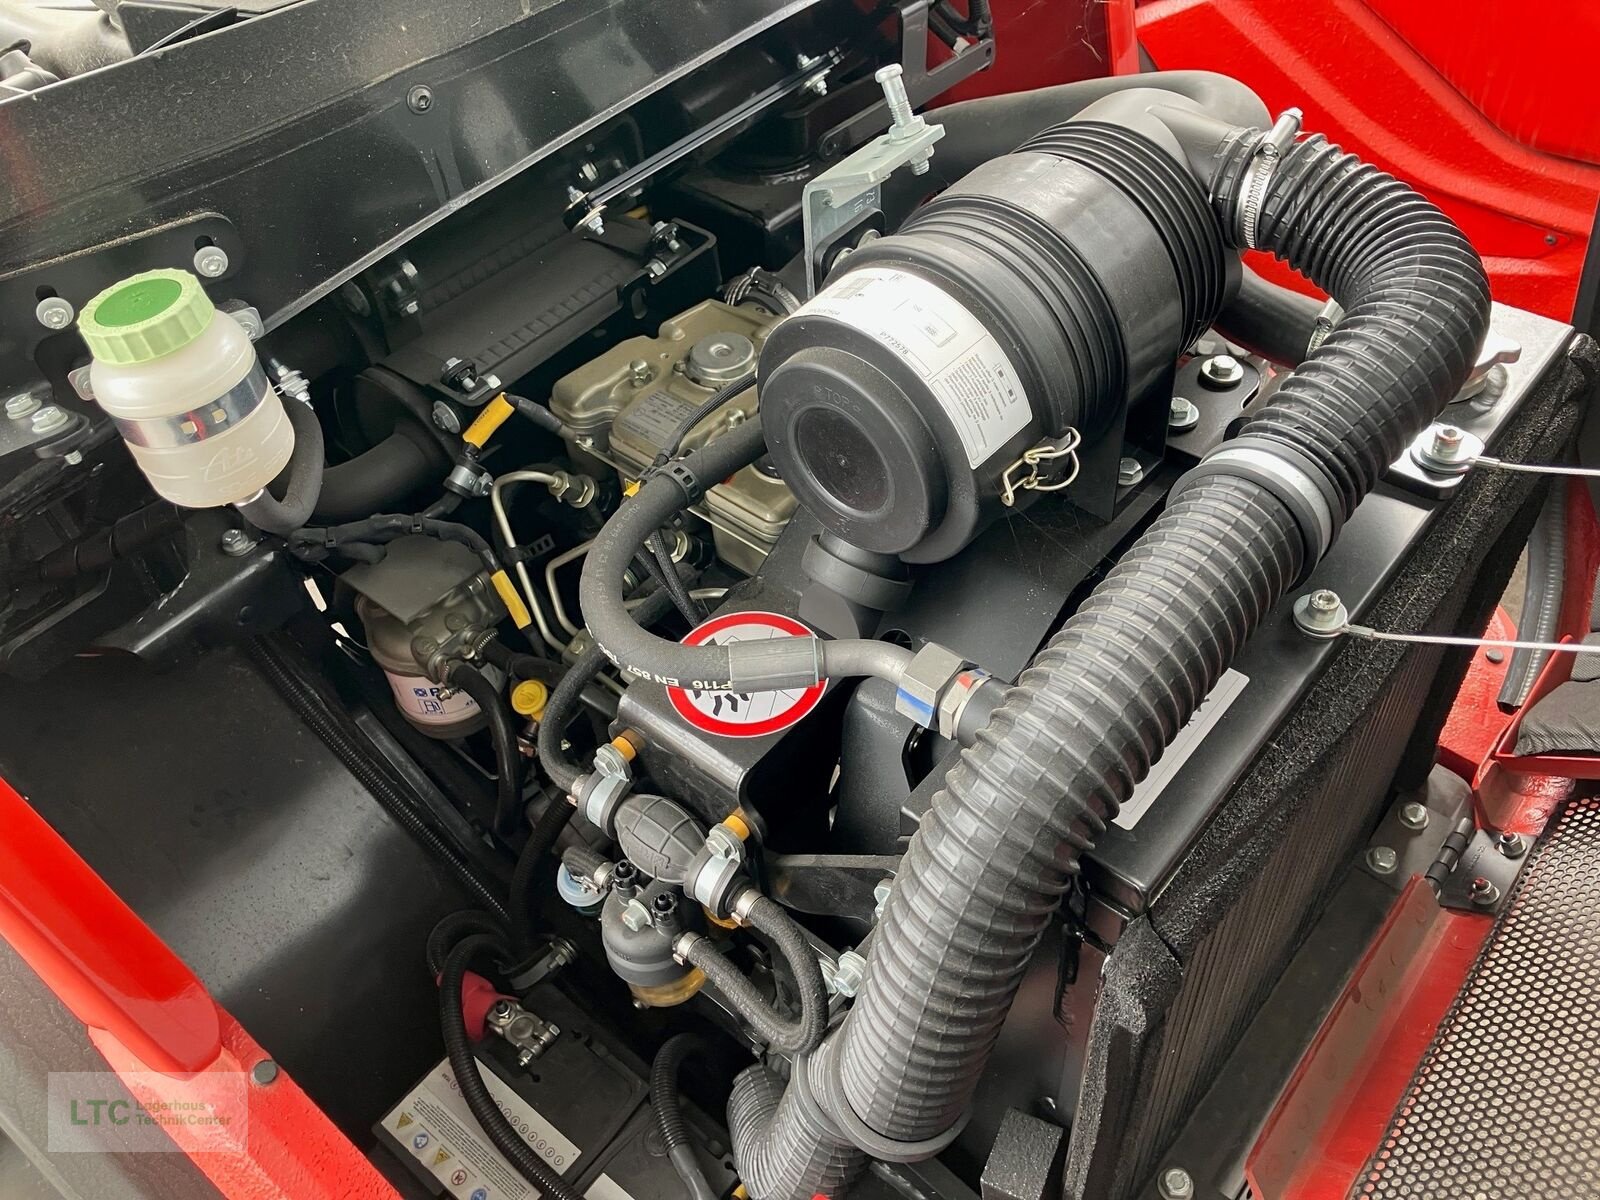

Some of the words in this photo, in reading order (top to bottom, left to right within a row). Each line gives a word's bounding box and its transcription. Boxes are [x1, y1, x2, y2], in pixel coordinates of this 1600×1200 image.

[880, 331, 909, 356] P772578
[825, 386, 850, 407] TOP
[655, 674, 680, 687] EN
